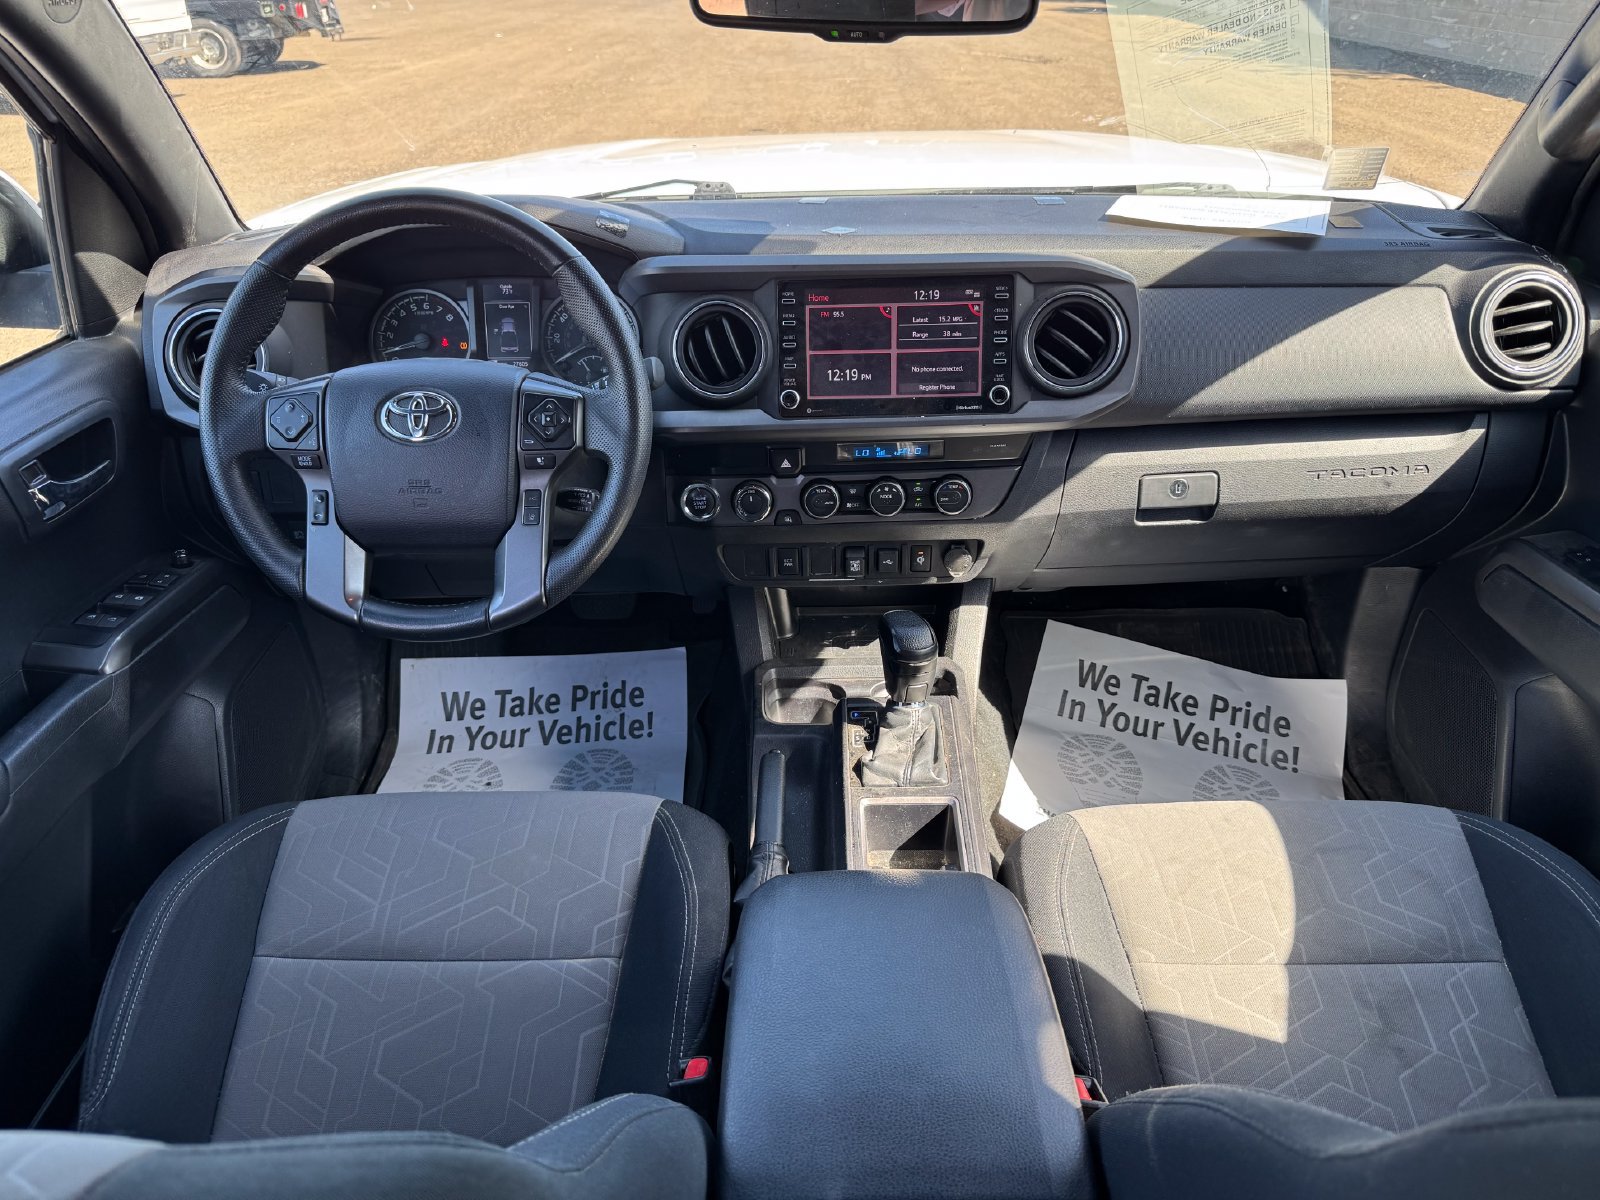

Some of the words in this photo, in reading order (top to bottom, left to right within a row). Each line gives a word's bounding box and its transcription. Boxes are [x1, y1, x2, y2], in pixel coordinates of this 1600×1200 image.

[808, 293, 830, 302] Home
[914, 289, 941, 301] 12:19
[938, 315, 951, 323] 15.2
[827, 368, 858, 382] 12:19
[861, 373, 872, 381] PM
[1306, 464, 1430, 481] TACOMA
[440, 691, 486, 722] We
[494, 686, 561, 718] Take
[571, 680, 645, 712] Pride
[1078, 658, 1121, 696] We
[1130, 673, 1199, 717] Take
[1209, 693, 1291, 738] Pride
[425, 728, 455, 754] In
[465, 725, 531, 751] Your
[538, 711, 654, 746] Vehicle!
[1057, 689, 1086, 722] In
[1097, 698, 1165, 740] Your
[1172, 718, 1300, 774] Vehicle!
